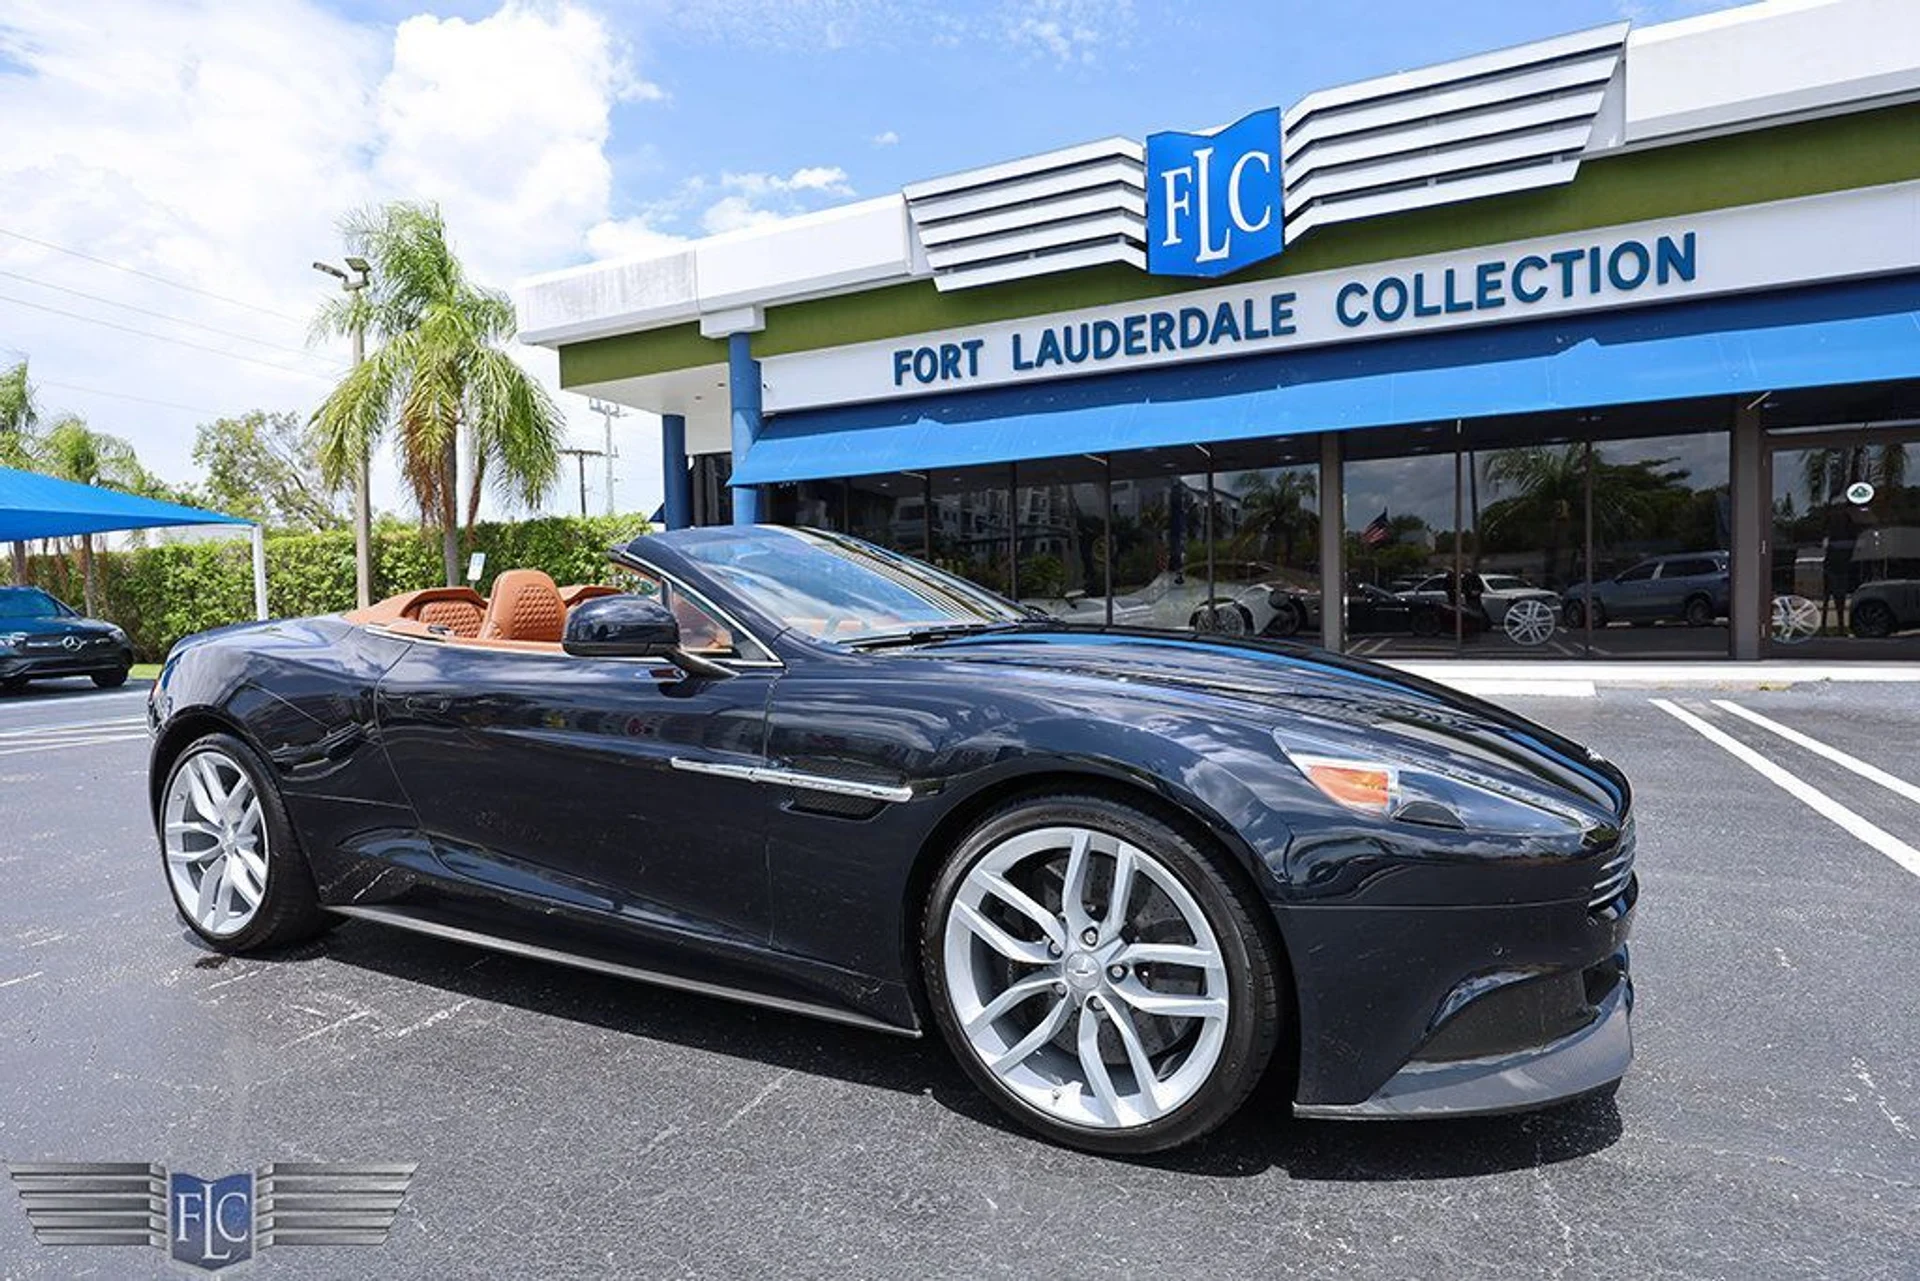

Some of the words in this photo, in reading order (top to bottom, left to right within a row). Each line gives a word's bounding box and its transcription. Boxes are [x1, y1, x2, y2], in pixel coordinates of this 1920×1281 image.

[1161, 147, 1271, 263] FLC
[894, 339, 984, 386] FORT
[1012, 292, 1297, 371] LAUDERDALE
[1336, 232, 1696, 327] COLLECTION
